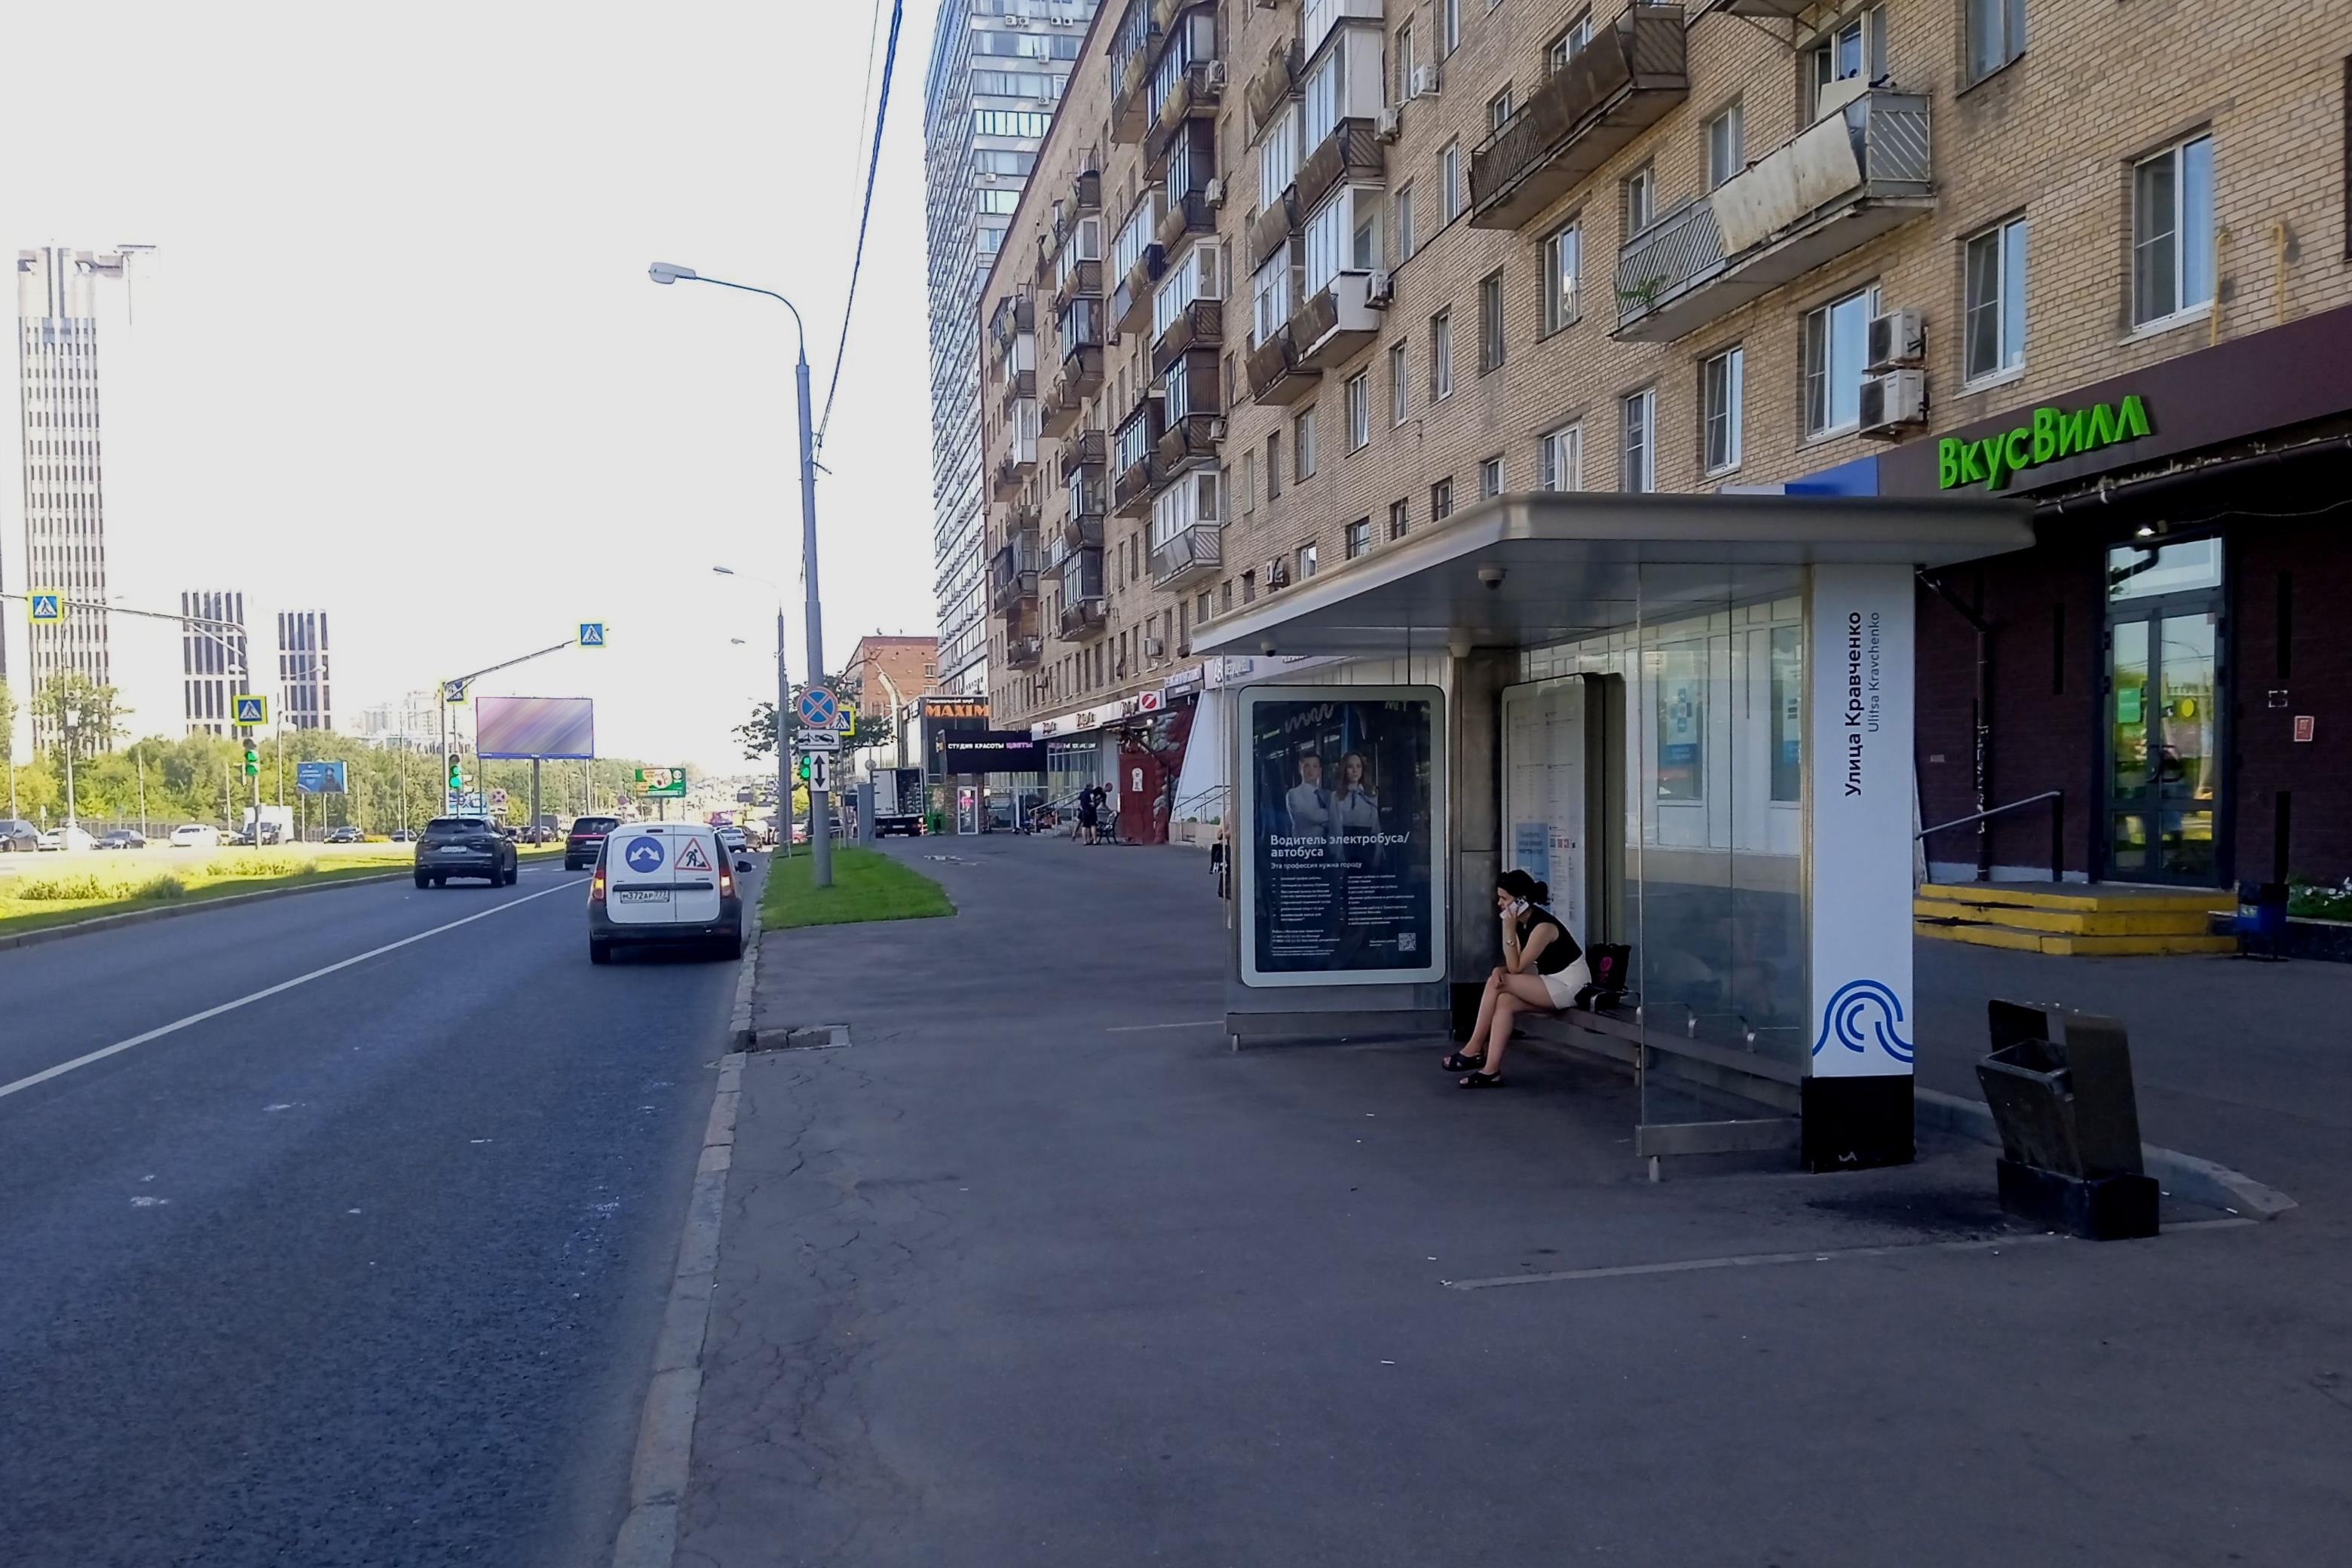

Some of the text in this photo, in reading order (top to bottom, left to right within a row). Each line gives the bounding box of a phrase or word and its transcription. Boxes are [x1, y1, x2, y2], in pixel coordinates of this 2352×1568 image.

[1868, 612, 1879, 732] Ulitsa Kravchenko
[925, 704, 989, 718] MAXIM
[1845, 611, 1864, 796] Улица Кравченко
[1270, 831, 1410, 847] Водитель электробуса/
[1270, 847, 1324, 859] автобуса
